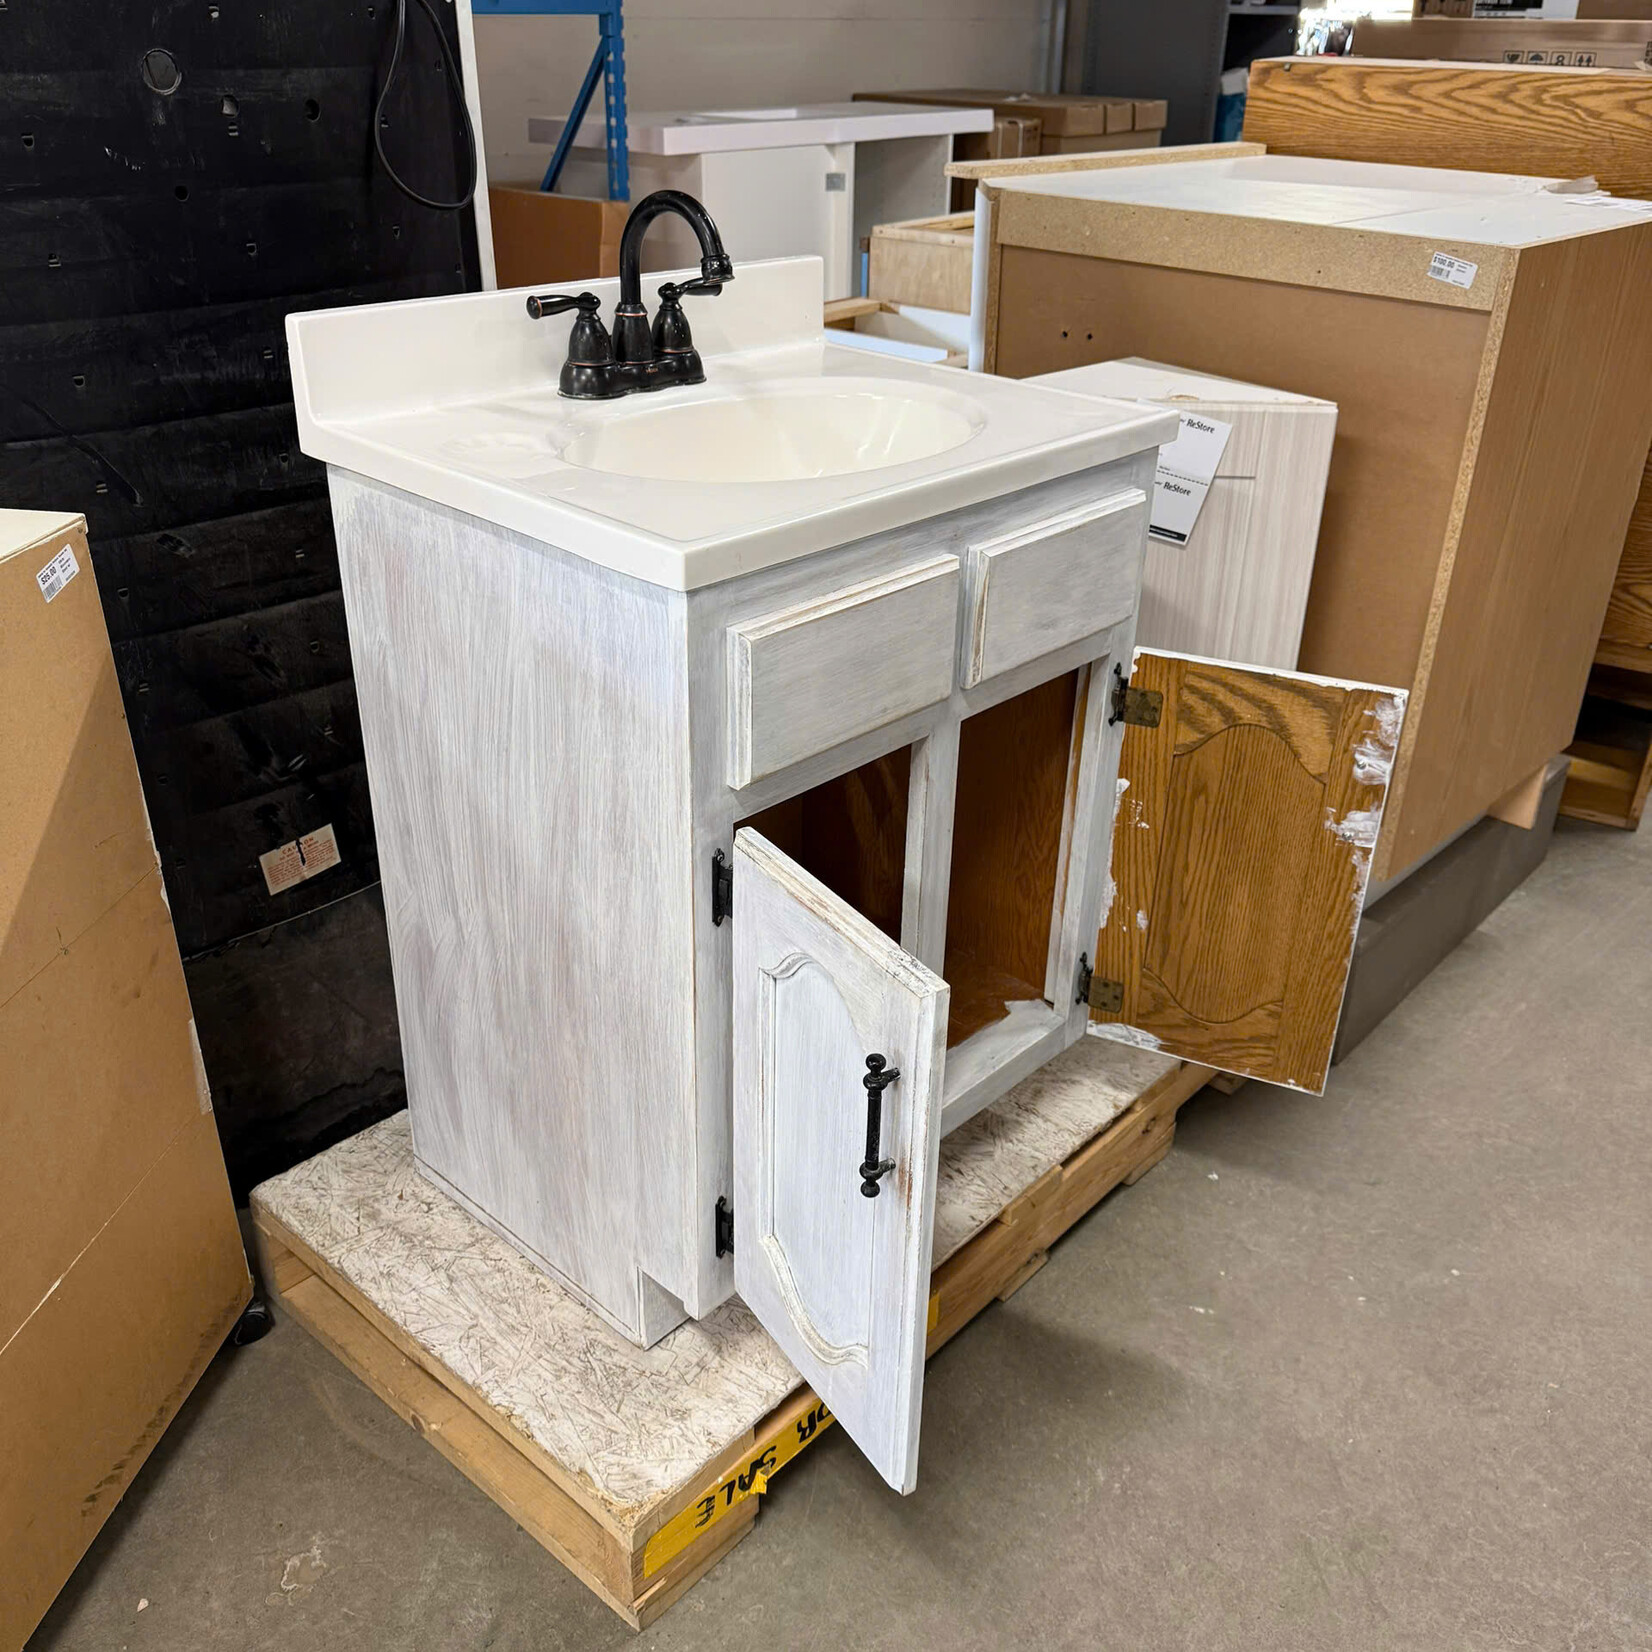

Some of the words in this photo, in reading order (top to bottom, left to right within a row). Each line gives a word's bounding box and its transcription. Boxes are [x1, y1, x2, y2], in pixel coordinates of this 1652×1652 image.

[1187, 418, 1215, 434] ReStore
[1163, 481, 1191, 497] ReStore
[282, 837, 314, 855] CAUON
[797, 1402, 831, 1443] OR
[695, 1446, 777, 1528] SALE
